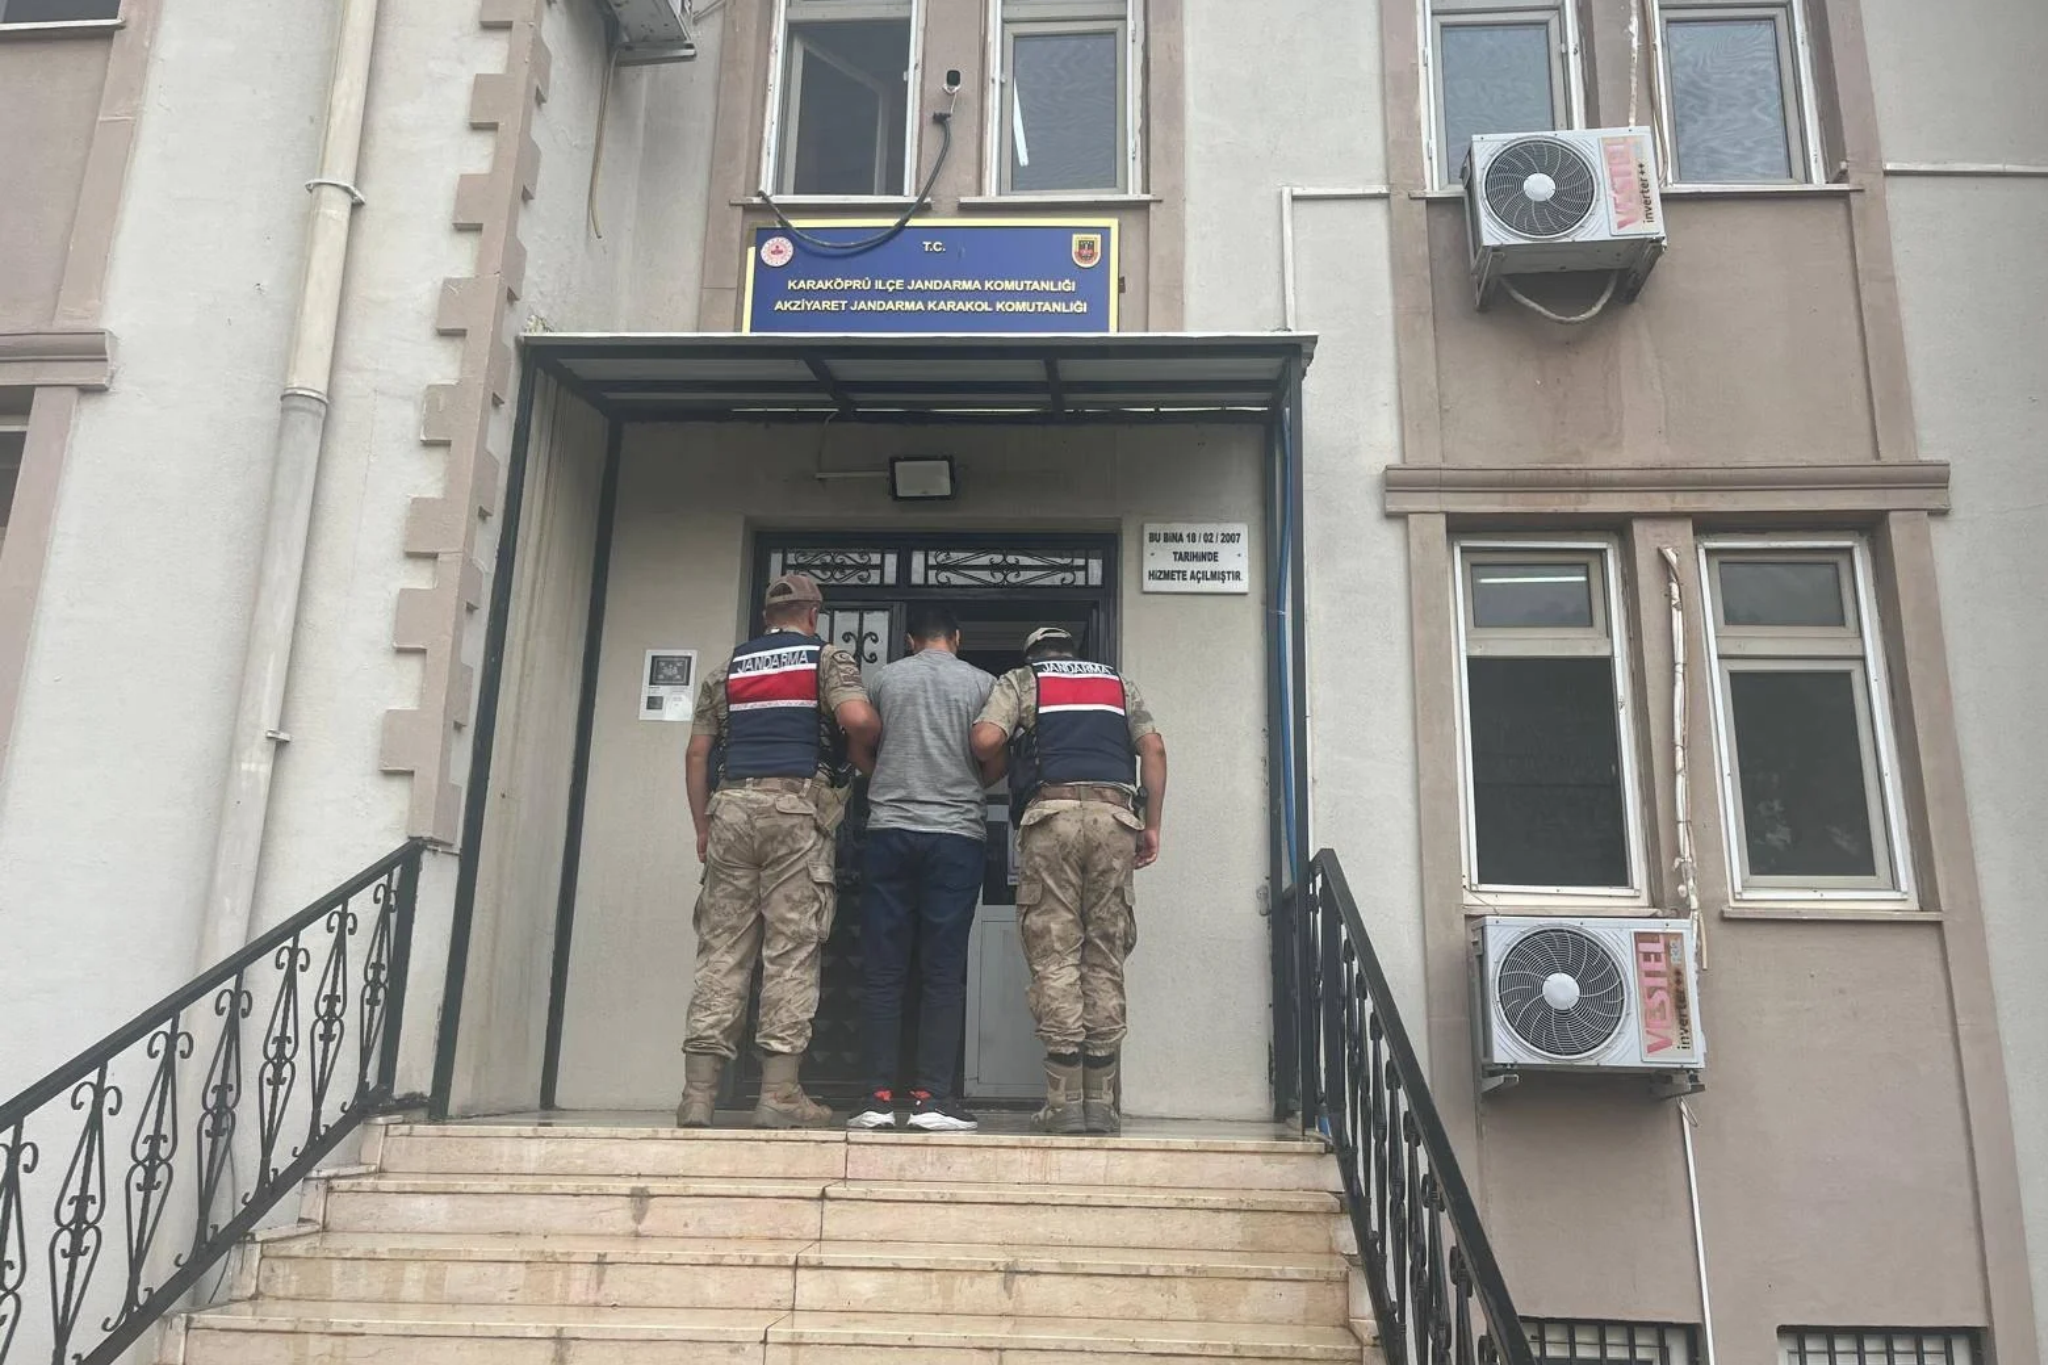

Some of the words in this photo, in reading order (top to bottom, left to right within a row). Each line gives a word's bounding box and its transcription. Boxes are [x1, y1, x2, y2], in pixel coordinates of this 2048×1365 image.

[922, 241, 946, 252] T.C.
[907, 280, 982, 291] JANDARMA
[984, 279, 1076, 292] KOMUTANLIĞI
[774, 299, 848, 311] AKZİYARET
[850, 300, 925, 311] JANDARMA
[927, 301, 993, 312] KARAKOL
[996, 300, 1087, 313] KOMUTANLIĞI
[1148, 532, 1161, 543] BU
[1203, 532, 1214, 543] 02
[1220, 533, 1241, 543] 2007
[737, 650, 809, 674] JANDARMA
[1042, 662, 1111, 675] JANDARMA
[1637, 934, 1673, 1054] VESTEL
